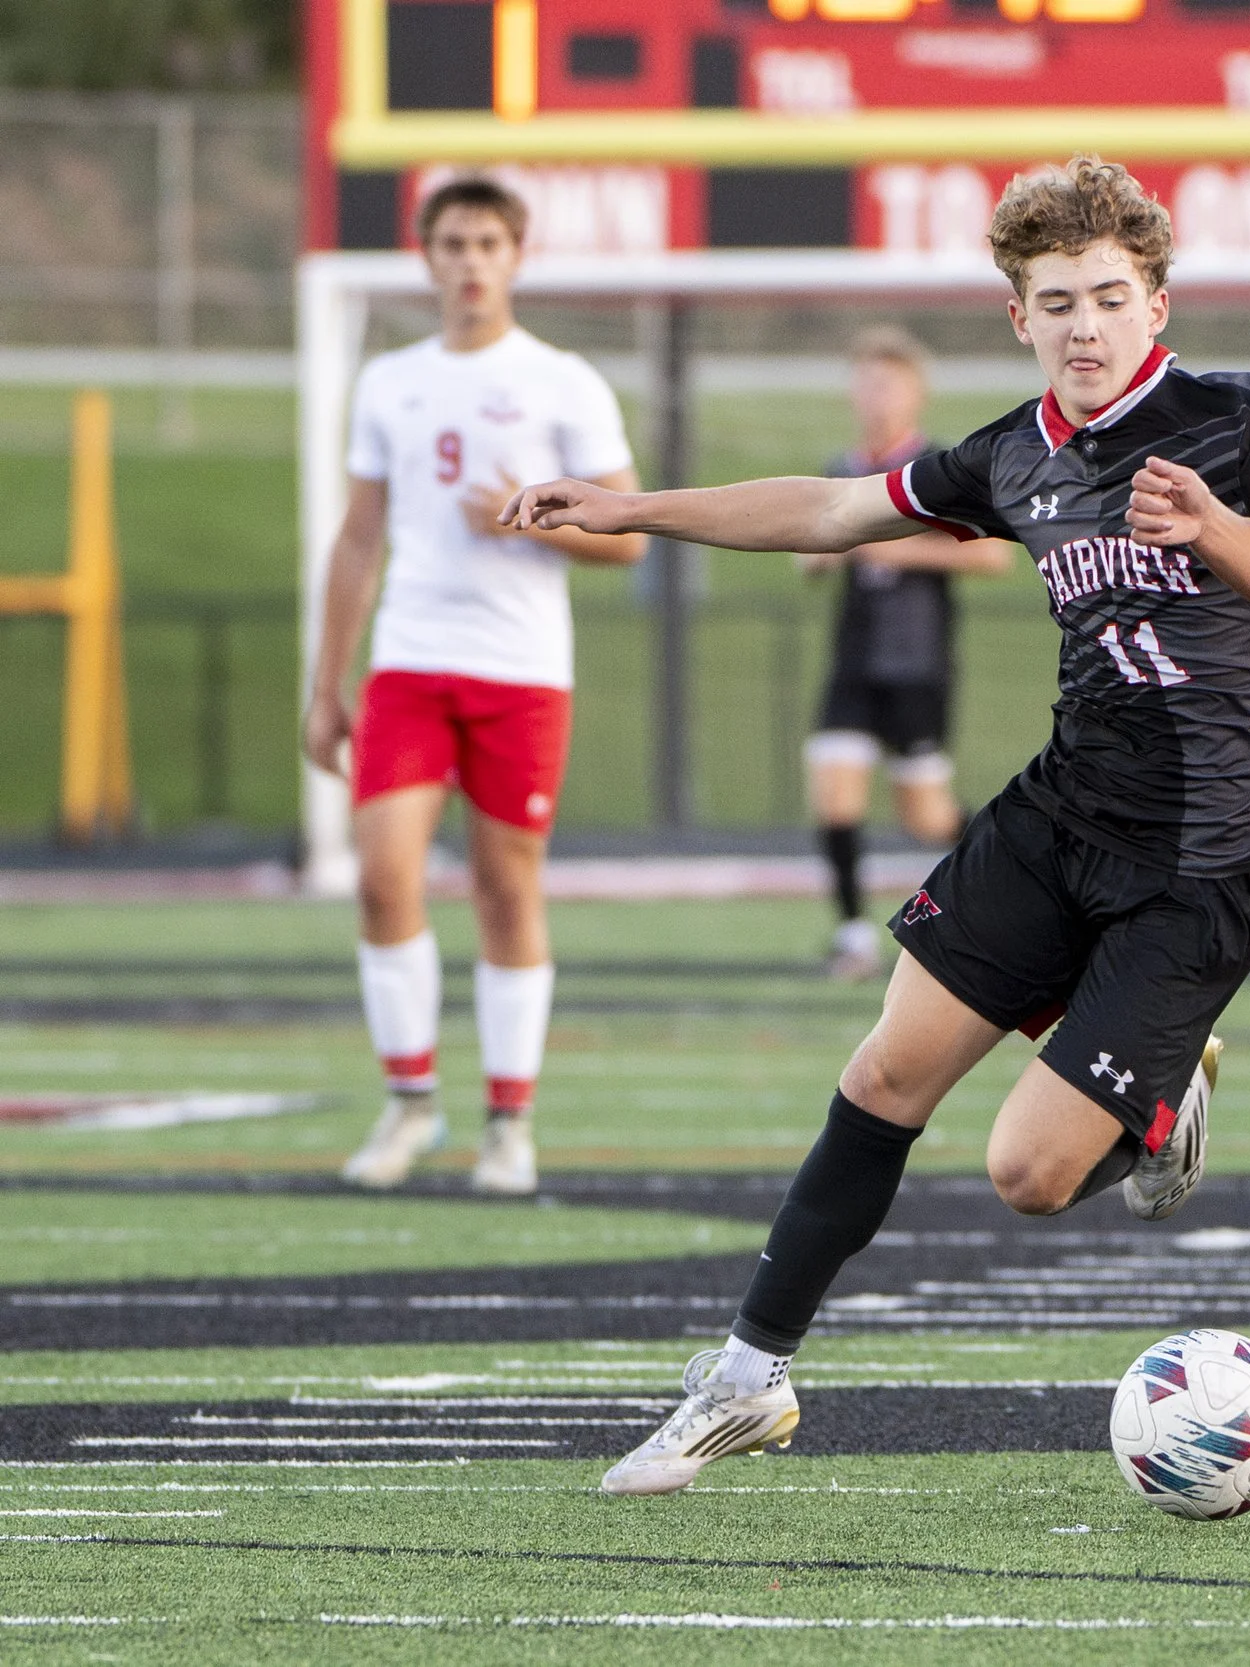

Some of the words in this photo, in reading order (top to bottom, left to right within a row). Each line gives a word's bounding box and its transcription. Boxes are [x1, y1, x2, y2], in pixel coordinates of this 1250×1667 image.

[436, 430, 463, 486] 9
[1037, 536, 1201, 614] FAIRVIEW
[1098, 620, 1192, 687] 11
